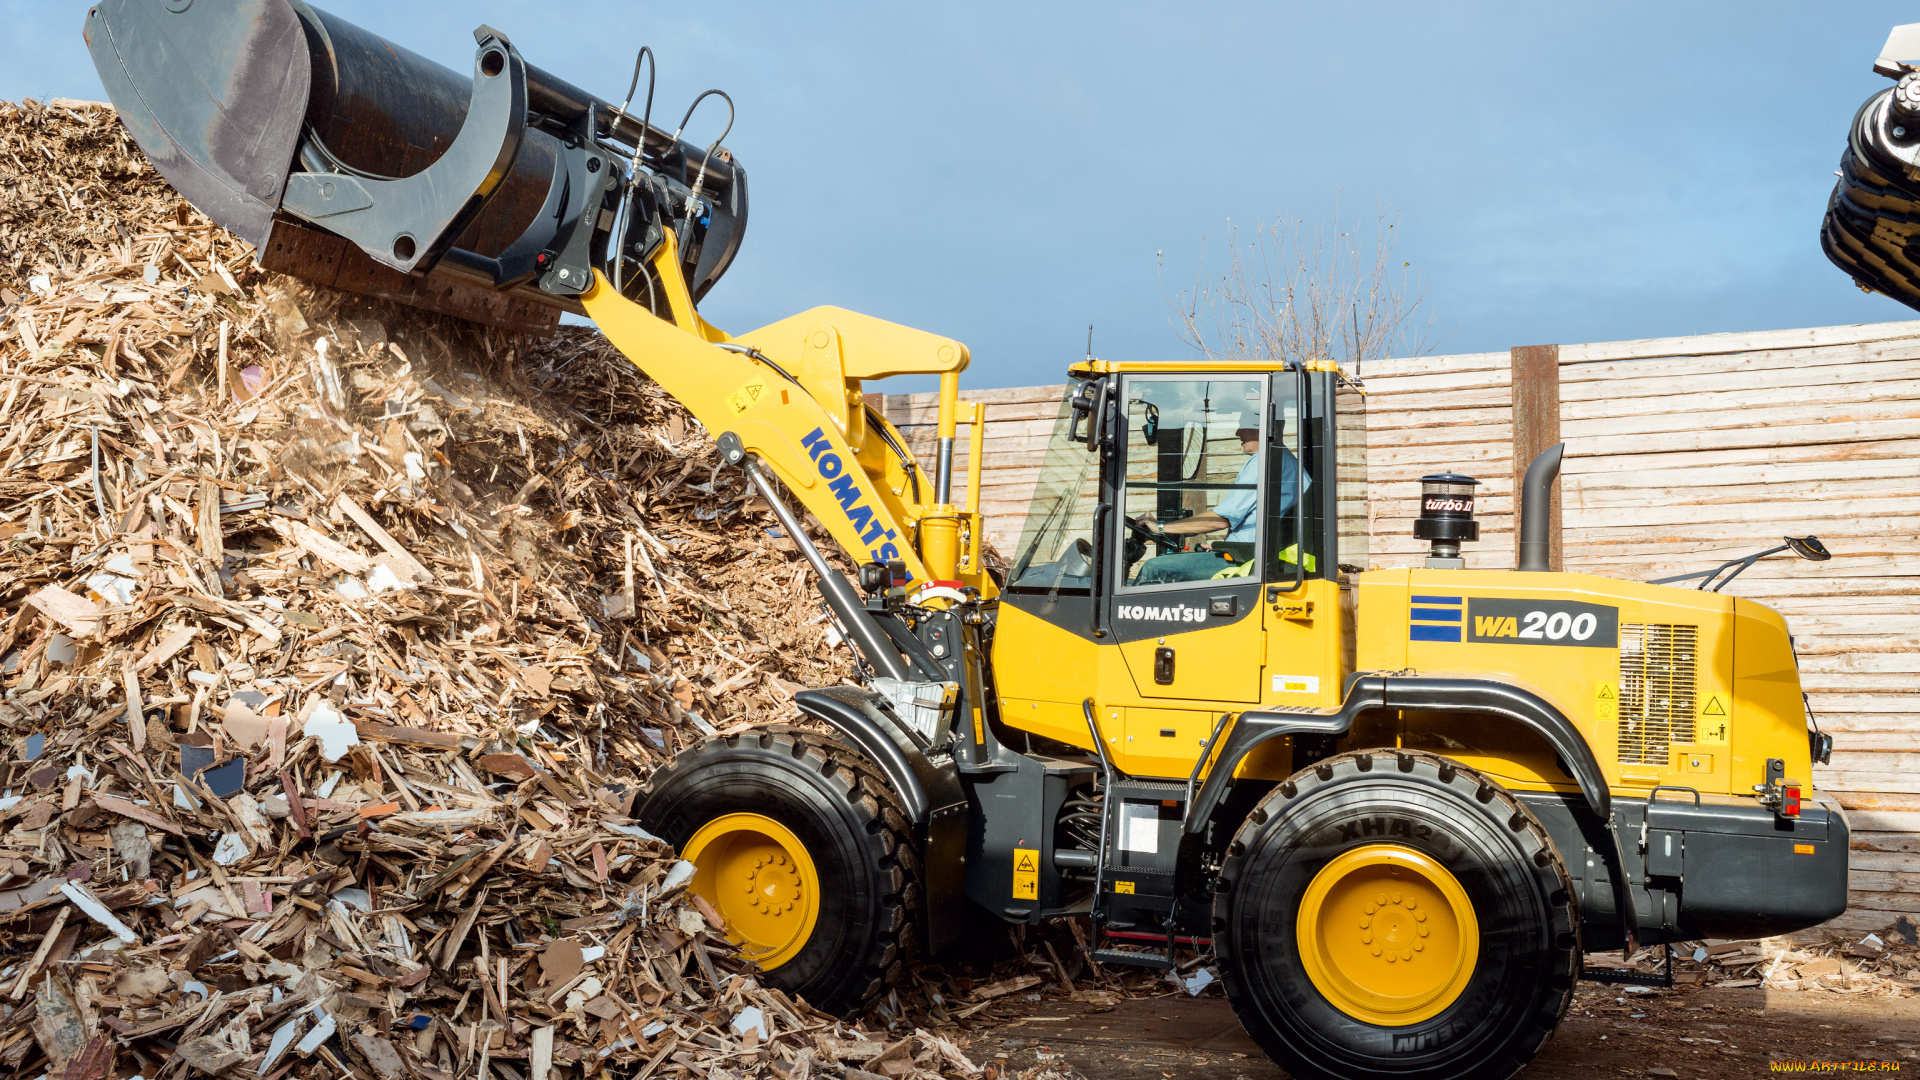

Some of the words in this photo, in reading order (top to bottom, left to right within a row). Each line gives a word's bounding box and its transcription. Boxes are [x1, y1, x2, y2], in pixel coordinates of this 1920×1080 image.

[800, 426, 914, 586] KOMATS
[1425, 498, 1464, 511] turbo
[1117, 603, 1207, 622] KOMATSU
[1474, 610, 1598, 641] WA200
